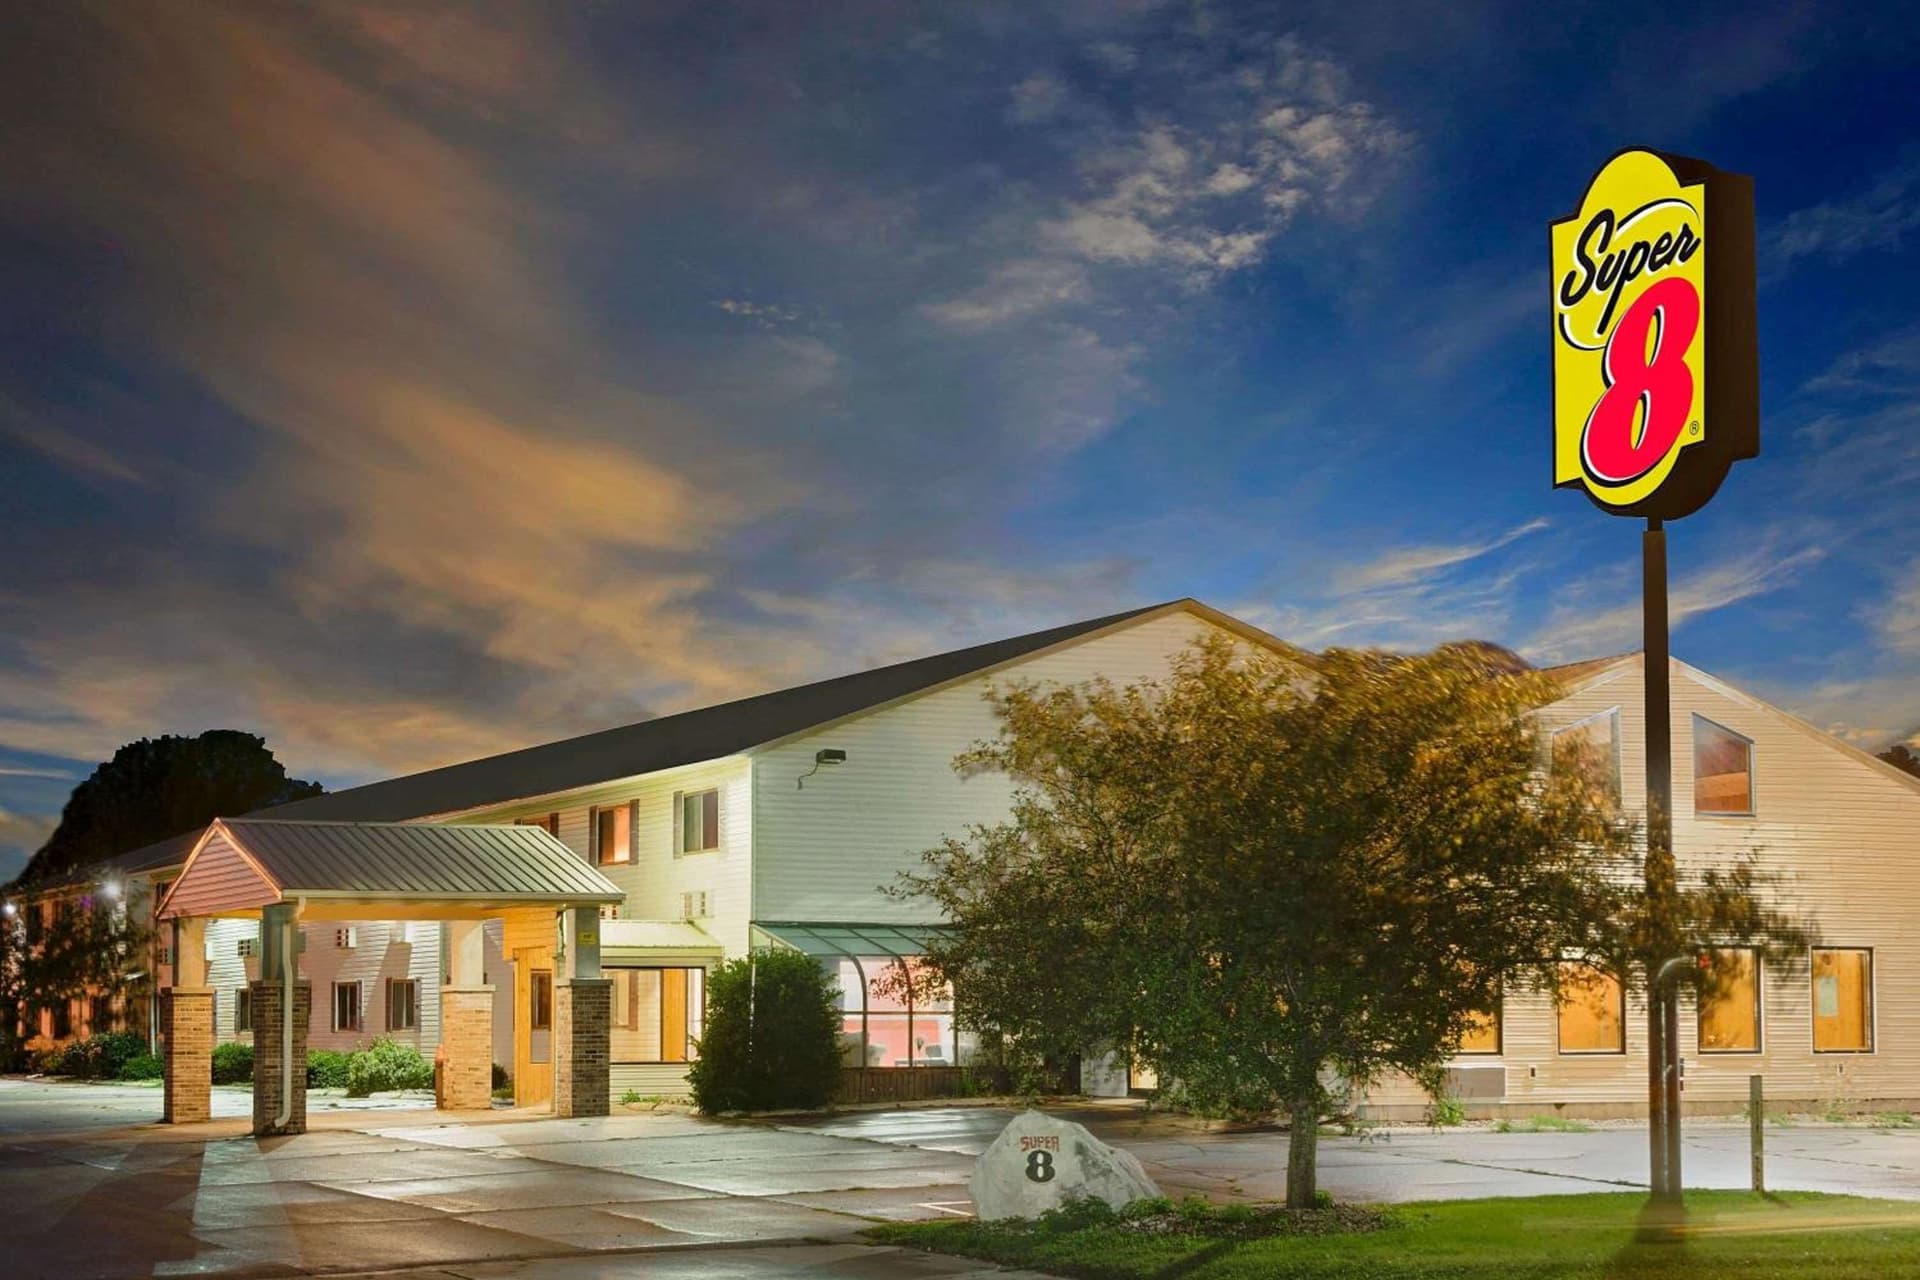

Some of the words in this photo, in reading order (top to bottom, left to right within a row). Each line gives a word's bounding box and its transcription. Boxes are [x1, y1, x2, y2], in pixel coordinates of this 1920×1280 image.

[1560, 208, 1701, 336] Super
[1580, 276, 1700, 486] 8
[1020, 1136, 1060, 1152] SUPER
[1025, 1150, 1056, 1183] 8
